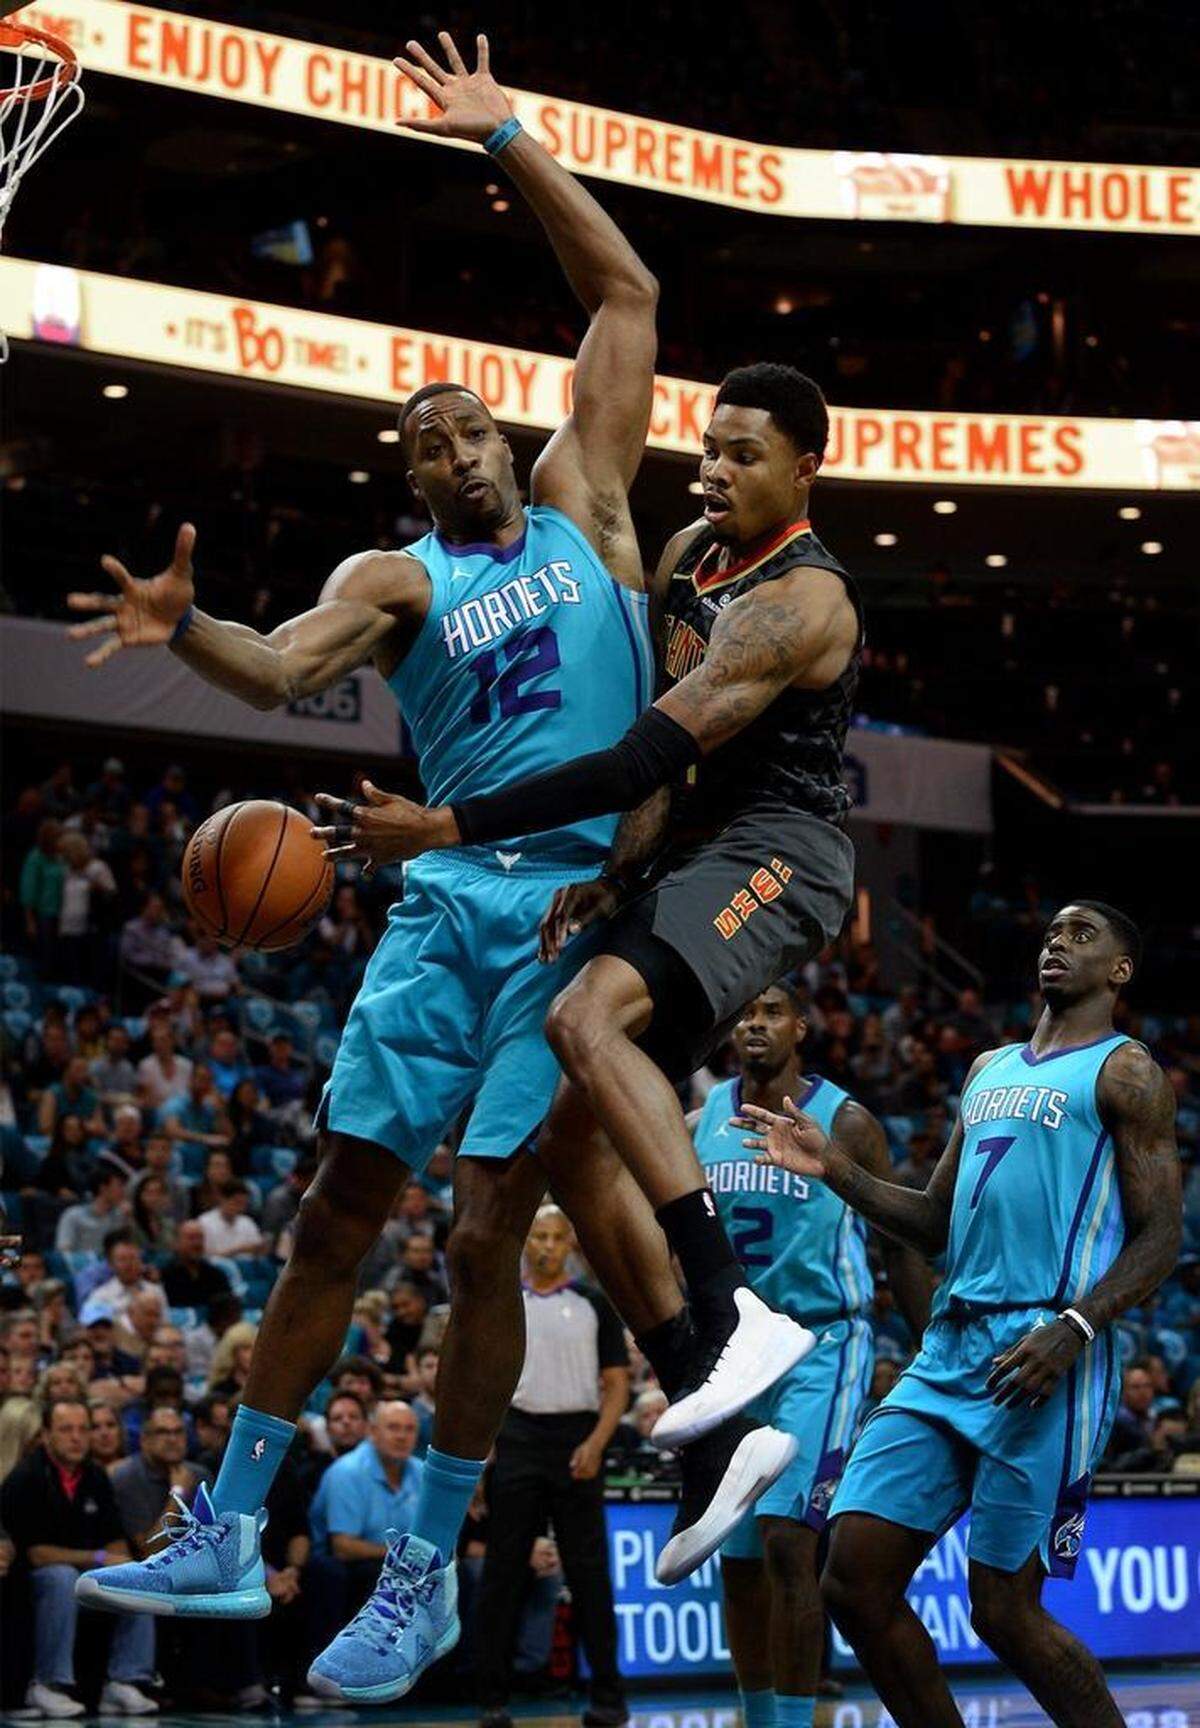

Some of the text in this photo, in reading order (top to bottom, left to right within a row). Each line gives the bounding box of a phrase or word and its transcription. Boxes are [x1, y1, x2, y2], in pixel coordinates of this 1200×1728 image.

[128, 13, 283, 96] ENJOY
[540, 106, 784, 204] SUPREMES
[1006, 166, 1194, 225] WHOLE
[823, 416, 1084, 476] UPREMES
[440, 559, 581, 658] HORNETS
[468, 626, 562, 724] 12
[970, 1135, 1018, 1210] 7
[731, 1206, 773, 1267] 2
[1085, 1545, 1188, 1613] YOU
